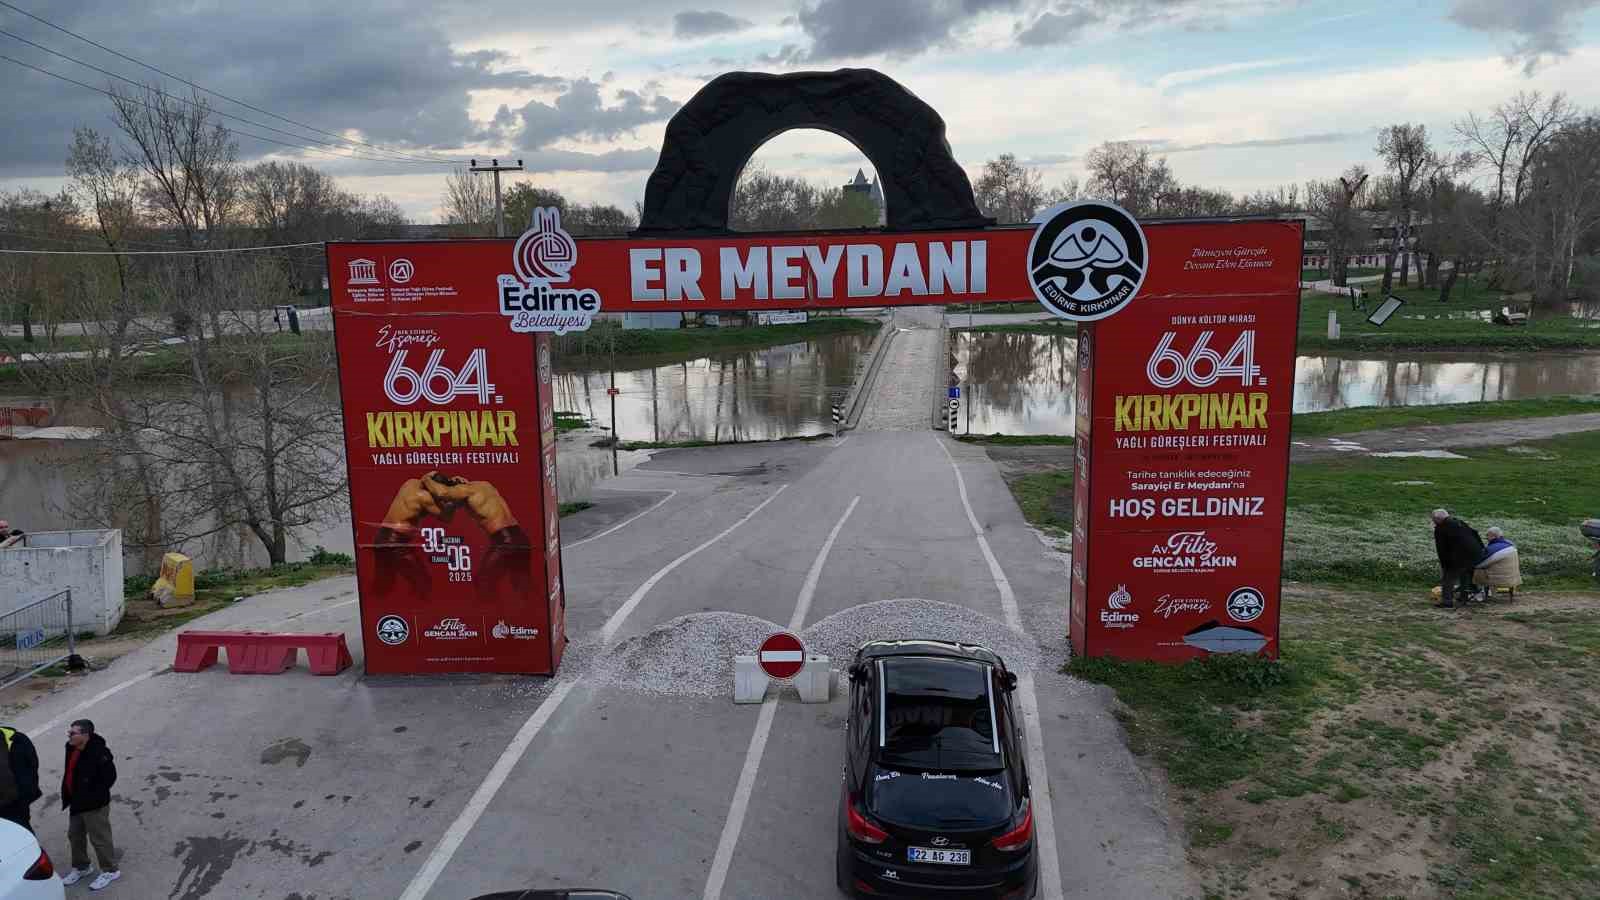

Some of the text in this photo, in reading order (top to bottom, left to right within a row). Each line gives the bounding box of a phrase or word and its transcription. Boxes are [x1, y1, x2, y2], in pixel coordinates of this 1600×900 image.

[629, 240, 987, 302] ER MEYDANI
[503, 286, 597, 311] Edirne
[1080, 286, 1131, 313] KIRKPINAR
[515, 312, 587, 331] Belediyesi
[1171, 315, 1197, 325] DÜNYA
[1199, 314, 1227, 324] KÜLTÜR
[1146, 329, 1268, 389] 664.
[383, 348, 503, 405] 664.
[1114, 392, 1269, 431] KIRKPINAR
[366, 410, 520, 448] KIRKPINAR
[1116, 434, 1267, 450] YAĞLI GÜREŞLERİ FESTİVALİ
[372, 451, 519, 467] YAĞLI GÜREŞLERİ FESTİVALİ
[1127, 469, 1251, 480] Tarihe tanıklık edeceğiniz
[1131, 480, 1245, 491] Sarayiçi Er Meydanı'na
[1109, 496, 1264, 520] HOŞ GELDİNİZ
[1152, 531, 1217, 559] Av. Filiz
[1132, 555, 1237, 568] GENCAN AKIN
[449, 571, 472, 582] 2025
[1101, 611, 1140, 621] Edirne
[424, 630, 457, 638] GENCAN
[510, 626, 539, 635] Edirne
[915, 850, 928, 860] 22
[932, 851, 945, 861] AG
